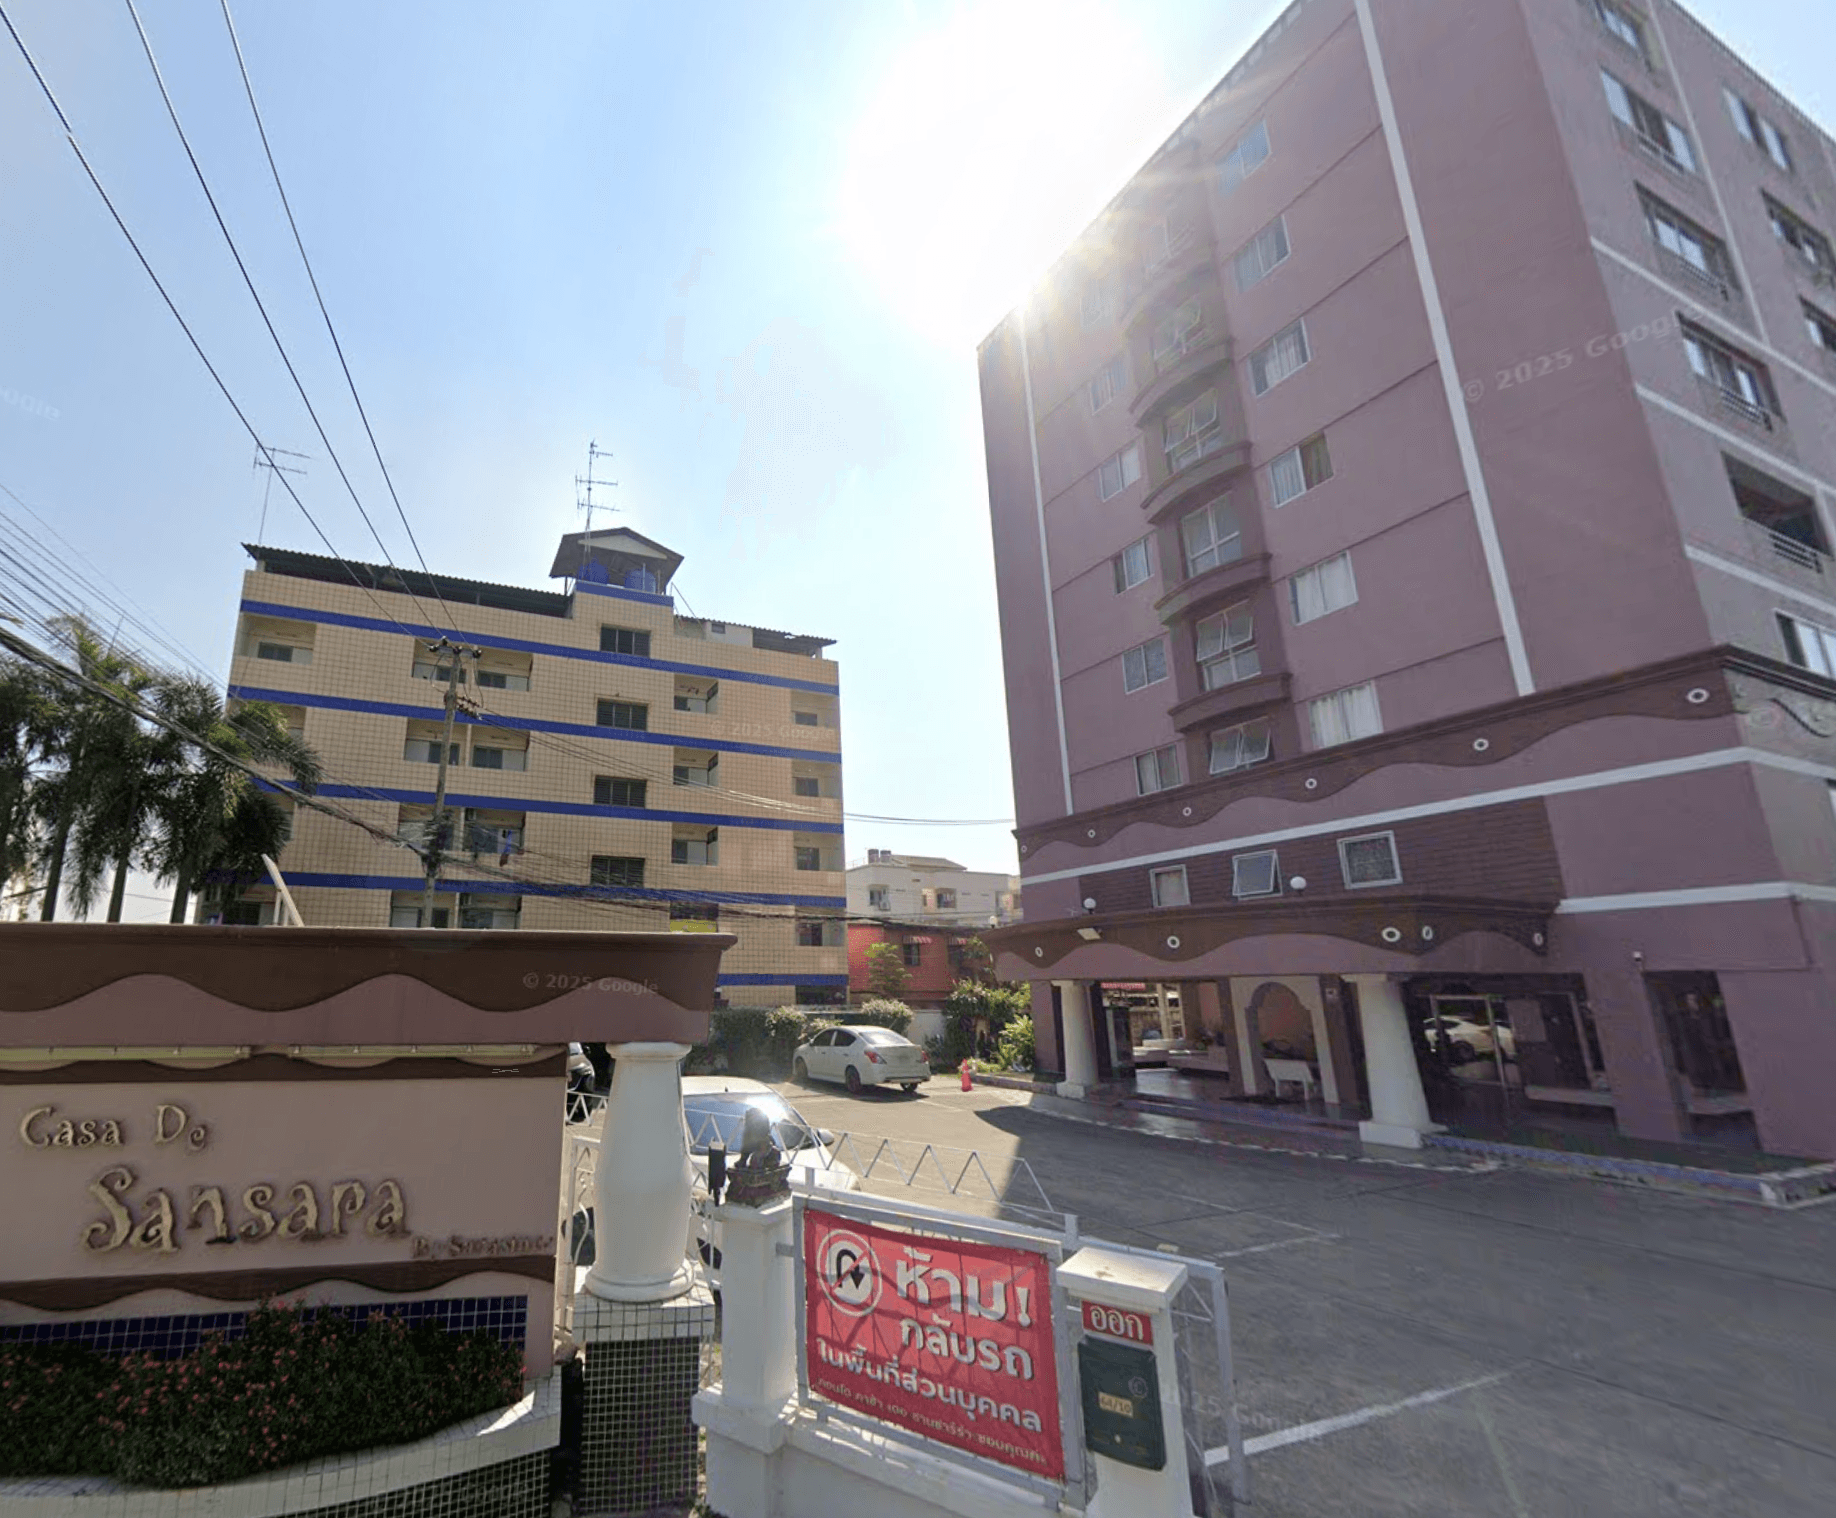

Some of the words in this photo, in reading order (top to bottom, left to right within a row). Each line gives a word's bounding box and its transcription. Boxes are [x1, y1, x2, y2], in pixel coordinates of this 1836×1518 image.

[20, 1107, 123, 1146] Casa
[156, 1104, 207, 1150] De
[896, 1245, 1032, 1328] ห้าม!
[900, 1312, 1035, 1380] กลับรถ
[1090, 1304, 1144, 1341] ออก
[816, 1337, 1043, 1433] ในพื้นที่ส่วนบุคคล
